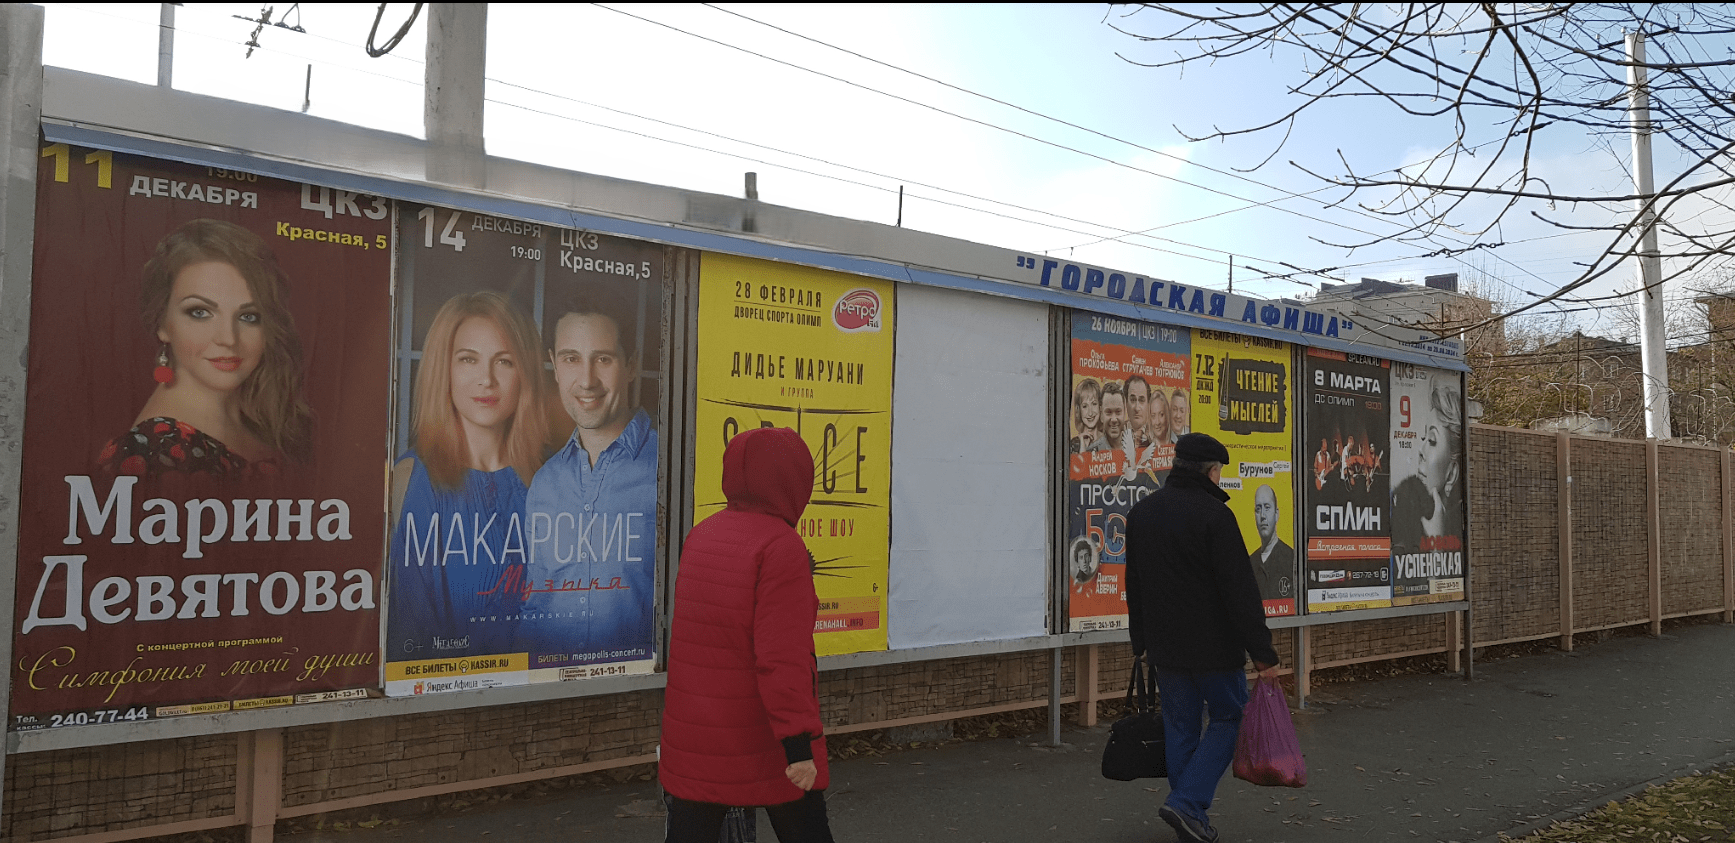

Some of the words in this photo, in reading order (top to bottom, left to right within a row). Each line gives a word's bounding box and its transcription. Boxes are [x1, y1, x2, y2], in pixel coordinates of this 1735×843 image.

[42, 142, 113, 189] 11
[129, 175, 259, 209] ДЕКАБРЯ
[300, 184, 388, 220] ЦКЗ
[276, 222, 369, 250] Красная,
[375, 234, 387, 249] 5
[418, 207, 466, 251] 14
[471, 215, 541, 238] ДЕКАБРЯ
[560, 229, 599, 251] ЦКЗ
[510, 245, 541, 261] 19:00
[735, 280, 751, 299] 28
[760, 284, 822, 308] ФЕВРАЛЯ
[734, 306, 764, 321] ДВОРЕЦ
[767, 309, 794, 324] СПОРТА
[796, 313, 822, 327] ОЛИМП
[839, 300, 877, 319] Ретро
[1091, 316, 1102, 332] 26
[1104, 318, 1137, 337] НОЯБРЯ
[731, 351, 785, 379] ДИДЬЕ
[795, 357, 864, 385] МАРУАНИ
[1079, 357, 1120, 371] ПРОКОФЬЕВА
[1122, 362, 1154, 376] СТРУГАЧЕВ
[1236, 369, 1279, 393] ЧТЕНИЕ
[1314, 369, 1325, 386] 8
[1330, 371, 1381, 394] МАРТА
[780, 386, 785, 396] И
[787, 387, 814, 399] ГРУППА
[1327, 396, 1355, 407] ОЛИМП
[1230, 400, 1279, 424] МЫСЛЕЙ
[1400, 395, 1412, 428] 9
[1394, 430, 1417, 440] ДЕКАБРЯ
[1088, 462, 1117, 476] НОСКОВ
[1239, 463, 1273, 477] Бурунов
[1080, 484, 1149, 506] ПРОСТО
[63, 475, 353, 558] Марина
[1316, 501, 1381, 531] СПЛИН
[830, 518, 854, 537] ШОУ
[404, 512, 644, 567] МАКАРСКИЕ
[1395, 551, 1462, 579] УСПЕНСКАЯ
[476, 564, 631, 601] Музыка
[22, 554, 376, 635] Девятова
[147, 640, 214, 651] концертной
[218, 636, 283, 648] программой
[572, 648, 646, 661] megapolis-concert.ru
[405, 666, 421, 675] ВСЕ
[422, 662, 457, 673] БИЛЕТЫ
[470, 658, 509, 671] KASSIR.RU
[537, 653, 569, 663] БИЛЕТЫ
[19, 645, 206, 703] Симфония
[220, 646, 299, 677] моей
[296, 652, 374, 681] души
[590, 665, 626, 677] 241-13-11
[322, 689, 364, 699] 241-13-11
[426, 681, 453, 693] Яндекс
[453, 679, 479, 691] Афиша
[16, 715, 38, 723] Тел.
[51, 706, 149, 728] 240-77-44
